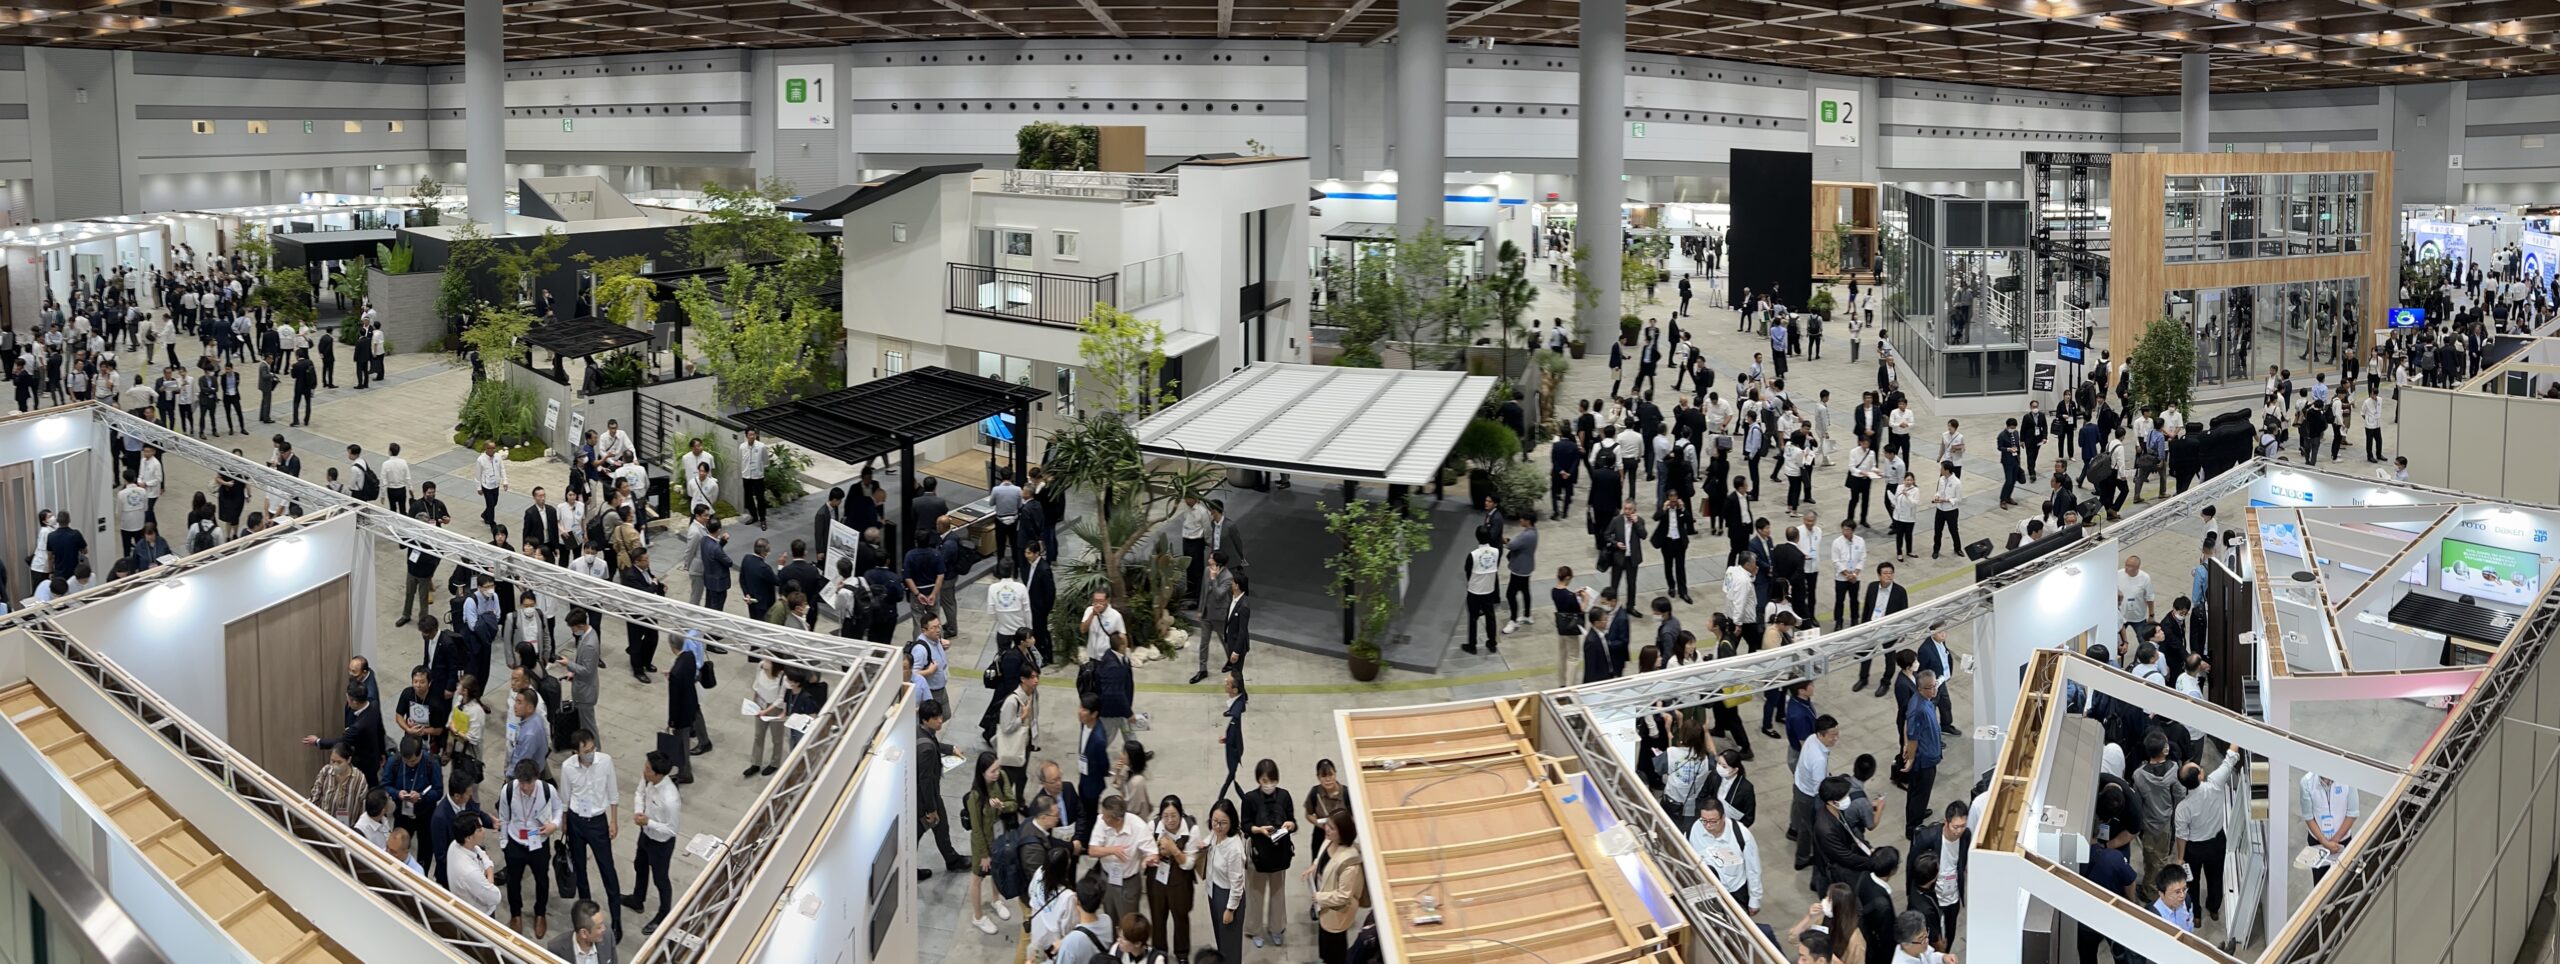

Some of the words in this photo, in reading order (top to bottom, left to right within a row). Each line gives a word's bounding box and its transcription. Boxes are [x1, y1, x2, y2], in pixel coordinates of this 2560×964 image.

[814, 78, 822, 102] 1
[1843, 102, 1853, 123] 2
[2461, 521, 2487, 531] TOTO
